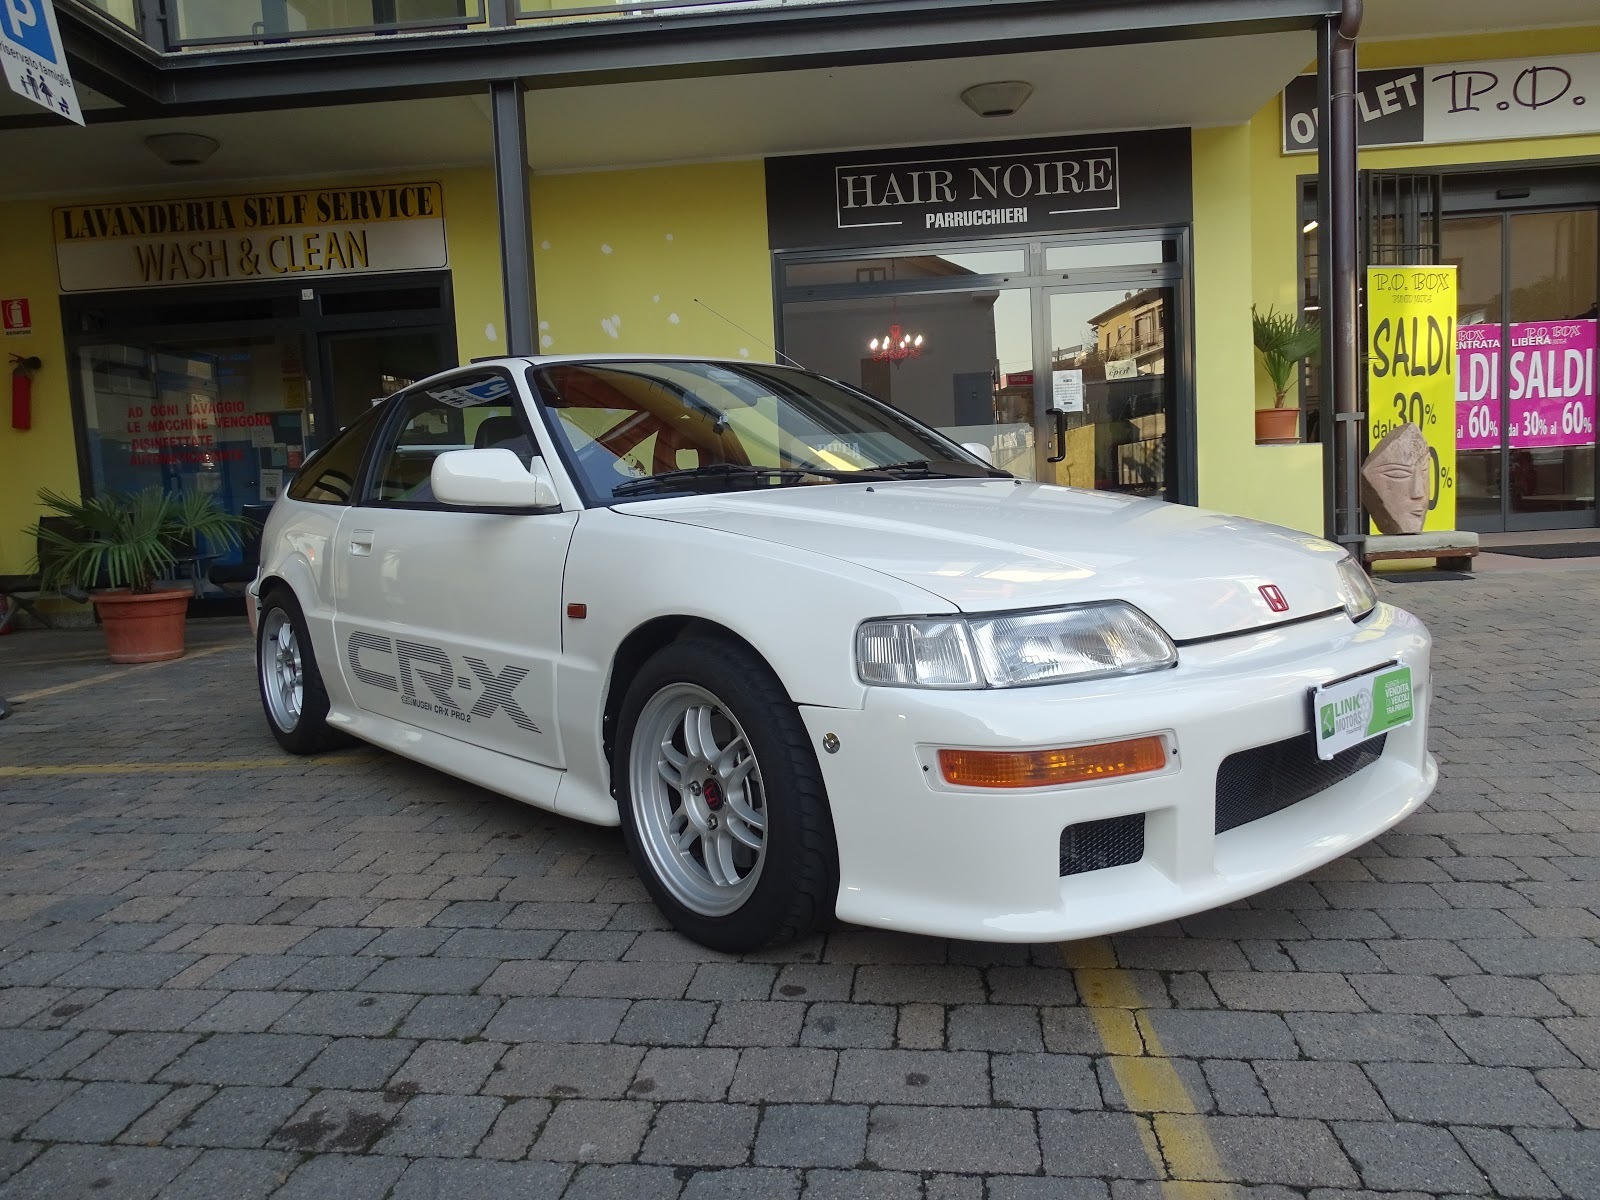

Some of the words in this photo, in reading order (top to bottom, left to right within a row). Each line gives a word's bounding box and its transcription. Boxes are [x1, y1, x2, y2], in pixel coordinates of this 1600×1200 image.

[4, 0, 37, 39] P
[40, 61, 72, 88] famiglie
[1290, 74, 1418, 144] OLET
[842, 170, 957, 209] HAIR
[968, 157, 1114, 201] NOIRE
[61, 200, 236, 240] LAVANDERIA
[244, 195, 307, 228] SELF
[317, 186, 434, 223] SERVICE
[926, 207, 1028, 229] PARRUCCHIERI
[134, 238, 230, 282] WASH
[239, 238, 259, 276] &
[265, 230, 369, 273] CLEAN
[1373, 273, 1408, 291] P.O.
[1413, 272, 1450, 293] BOX
[1456, 339, 1500, 349] ENTRATA
[1512, 336, 1551, 347] LIBERA
[1457, 329, 1486, 341] BOX
[1551, 325, 1581, 338] BOX
[1373, 315, 1453, 377] SALDI
[1456, 352, 1498, 401] LDI
[1509, 348, 1593, 399] SALDI
[128, 406, 143, 418] AD
[151, 404, 178, 417] OGNI
[186, 401, 245, 414] LAVAGGIO
[1467, 405, 1498, 438] 60%
[1523, 411, 1548, 436] 30%
[1550, 421, 1556, 434] al
[1561, 401, 1592, 434] 60%
[127, 421, 141, 433] LE
[148, 417, 208, 432] MACCHINE
[215, 414, 272, 428] VENGONO
[348, 631, 543, 734] CR-X
[1385, 682, 1409, 698] VENDITA
[412, 698, 432, 711] MUGEN
[1335, 693, 1361, 717] LINK
[1336, 711, 1362, 733] MOTORS
